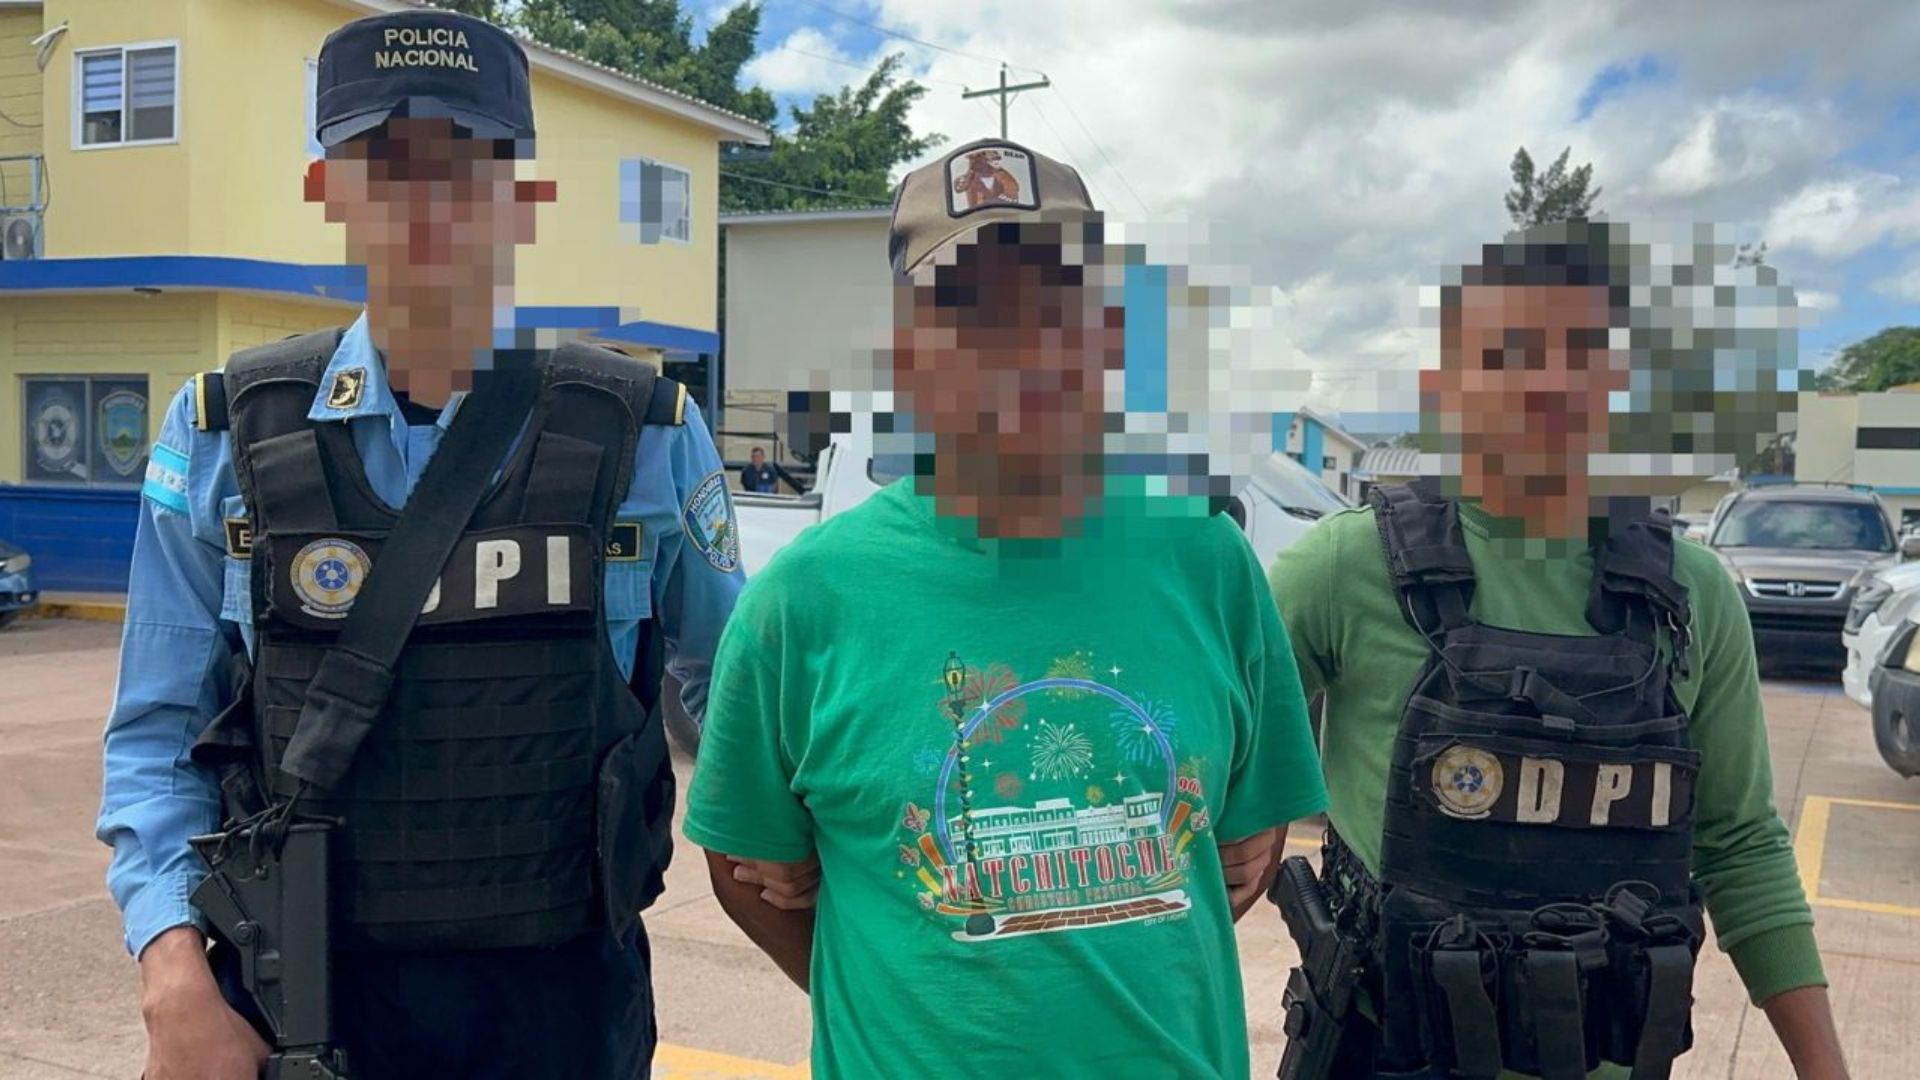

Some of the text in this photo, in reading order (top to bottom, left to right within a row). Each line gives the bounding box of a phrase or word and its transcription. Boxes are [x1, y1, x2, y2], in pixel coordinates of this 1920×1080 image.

[375, 49, 479, 72] NACIONAL
[384, 28, 469, 49] POLICIA
[420, 535, 571, 614] PI
[1516, 756, 1672, 827] DPI
